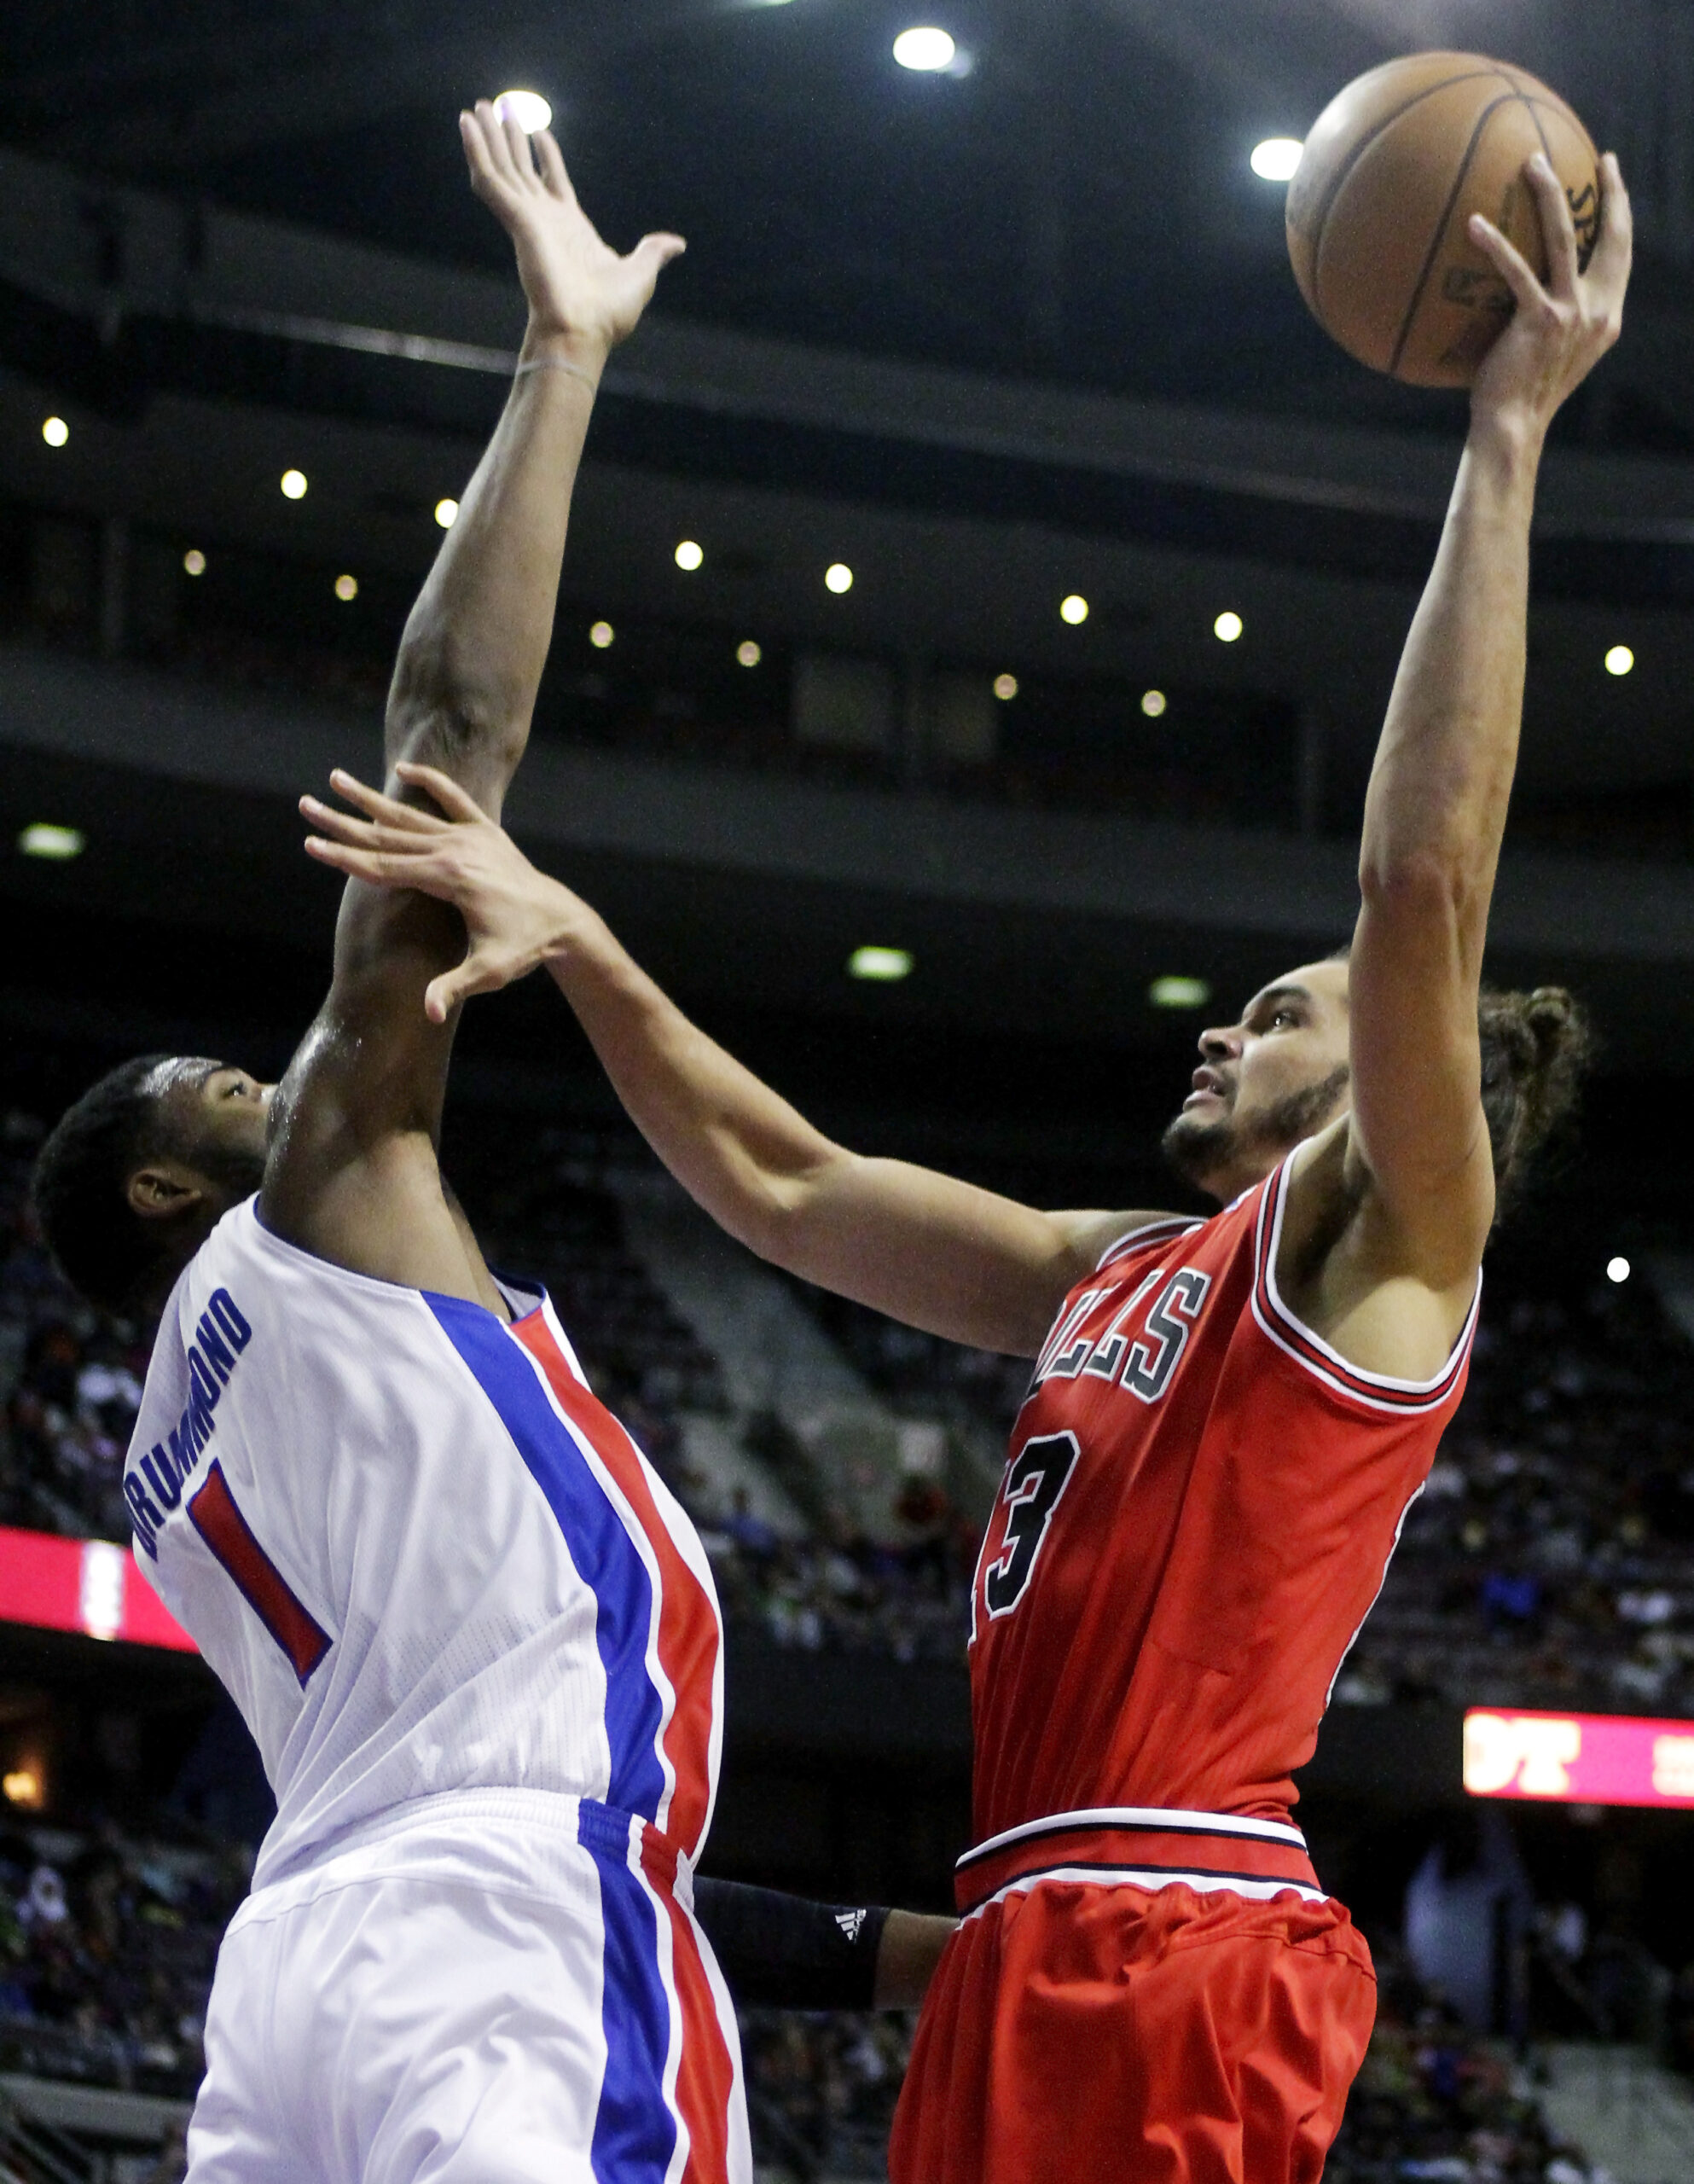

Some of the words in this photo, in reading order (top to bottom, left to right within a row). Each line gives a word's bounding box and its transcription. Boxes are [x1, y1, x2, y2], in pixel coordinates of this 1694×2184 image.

[1023, 1267, 1211, 1404] ULLS
[186, 1457, 334, 1691] 1
[968, 1430, 1081, 1647] 3
